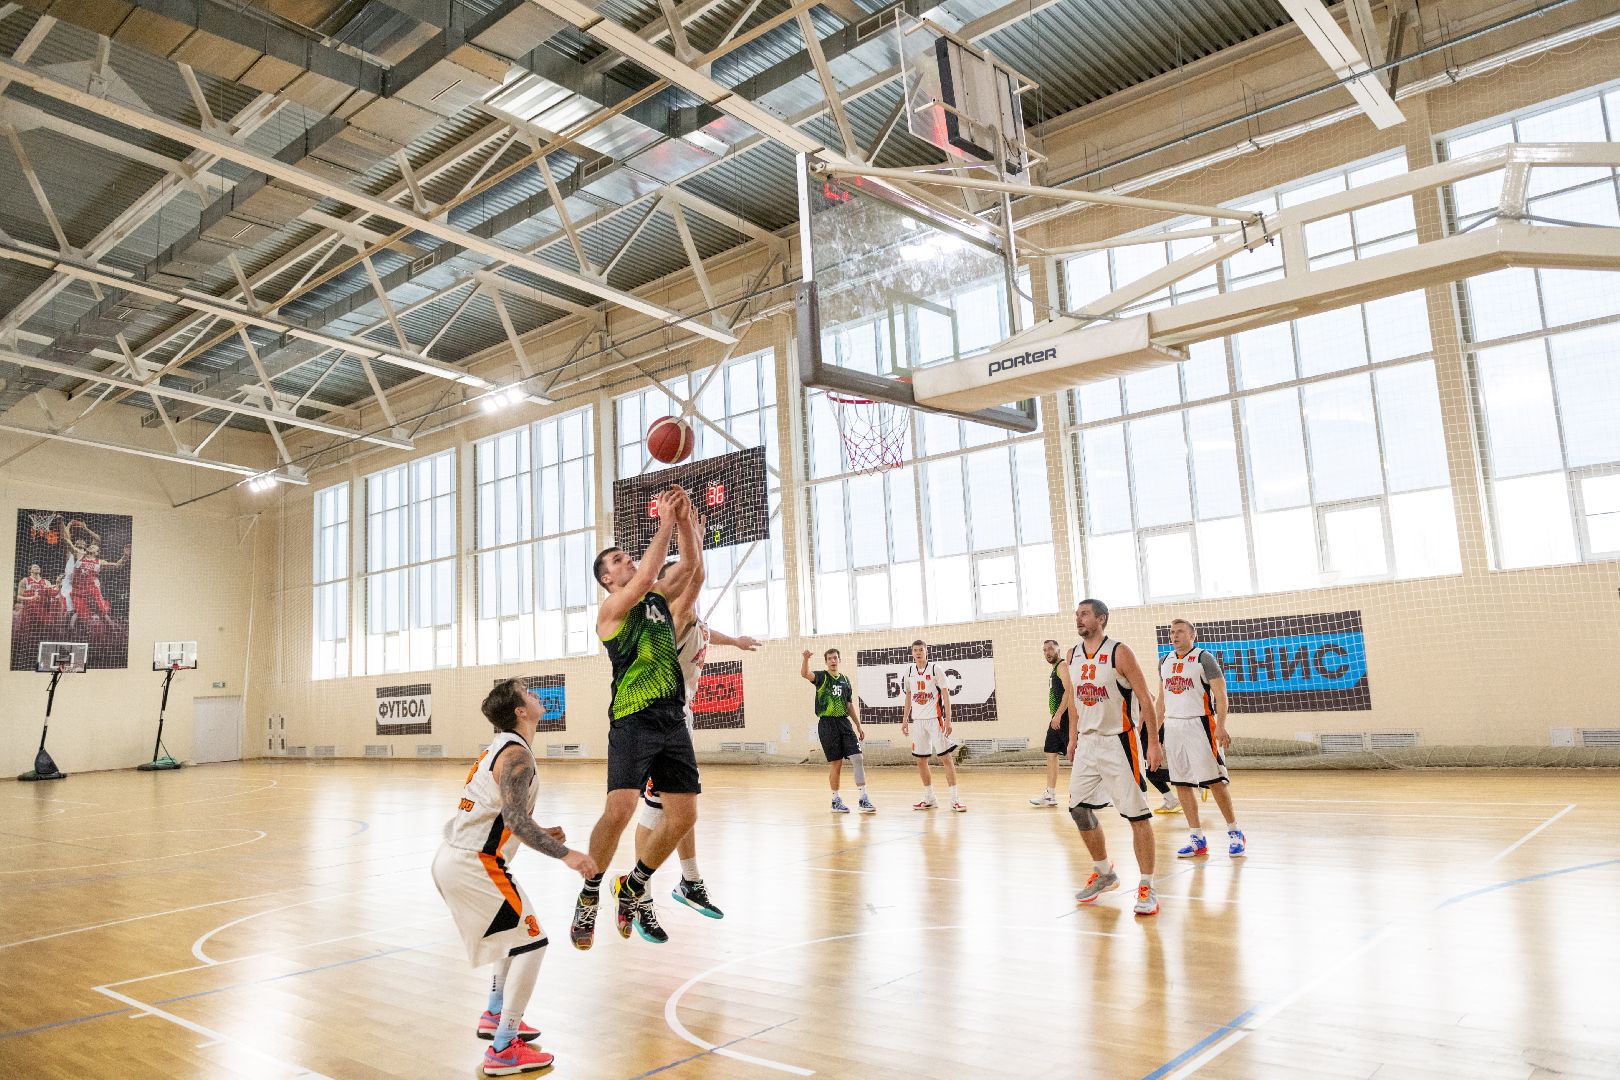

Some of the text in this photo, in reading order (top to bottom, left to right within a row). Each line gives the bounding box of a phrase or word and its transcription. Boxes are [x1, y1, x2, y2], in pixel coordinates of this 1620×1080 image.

[1216, 643, 1349, 682] ННИС
[832, 684, 843, 697] 35
[886, 668, 963, 699] БС
[378, 698, 427, 719] ФУТБОЛ
[524, 914, 541, 938] 3
